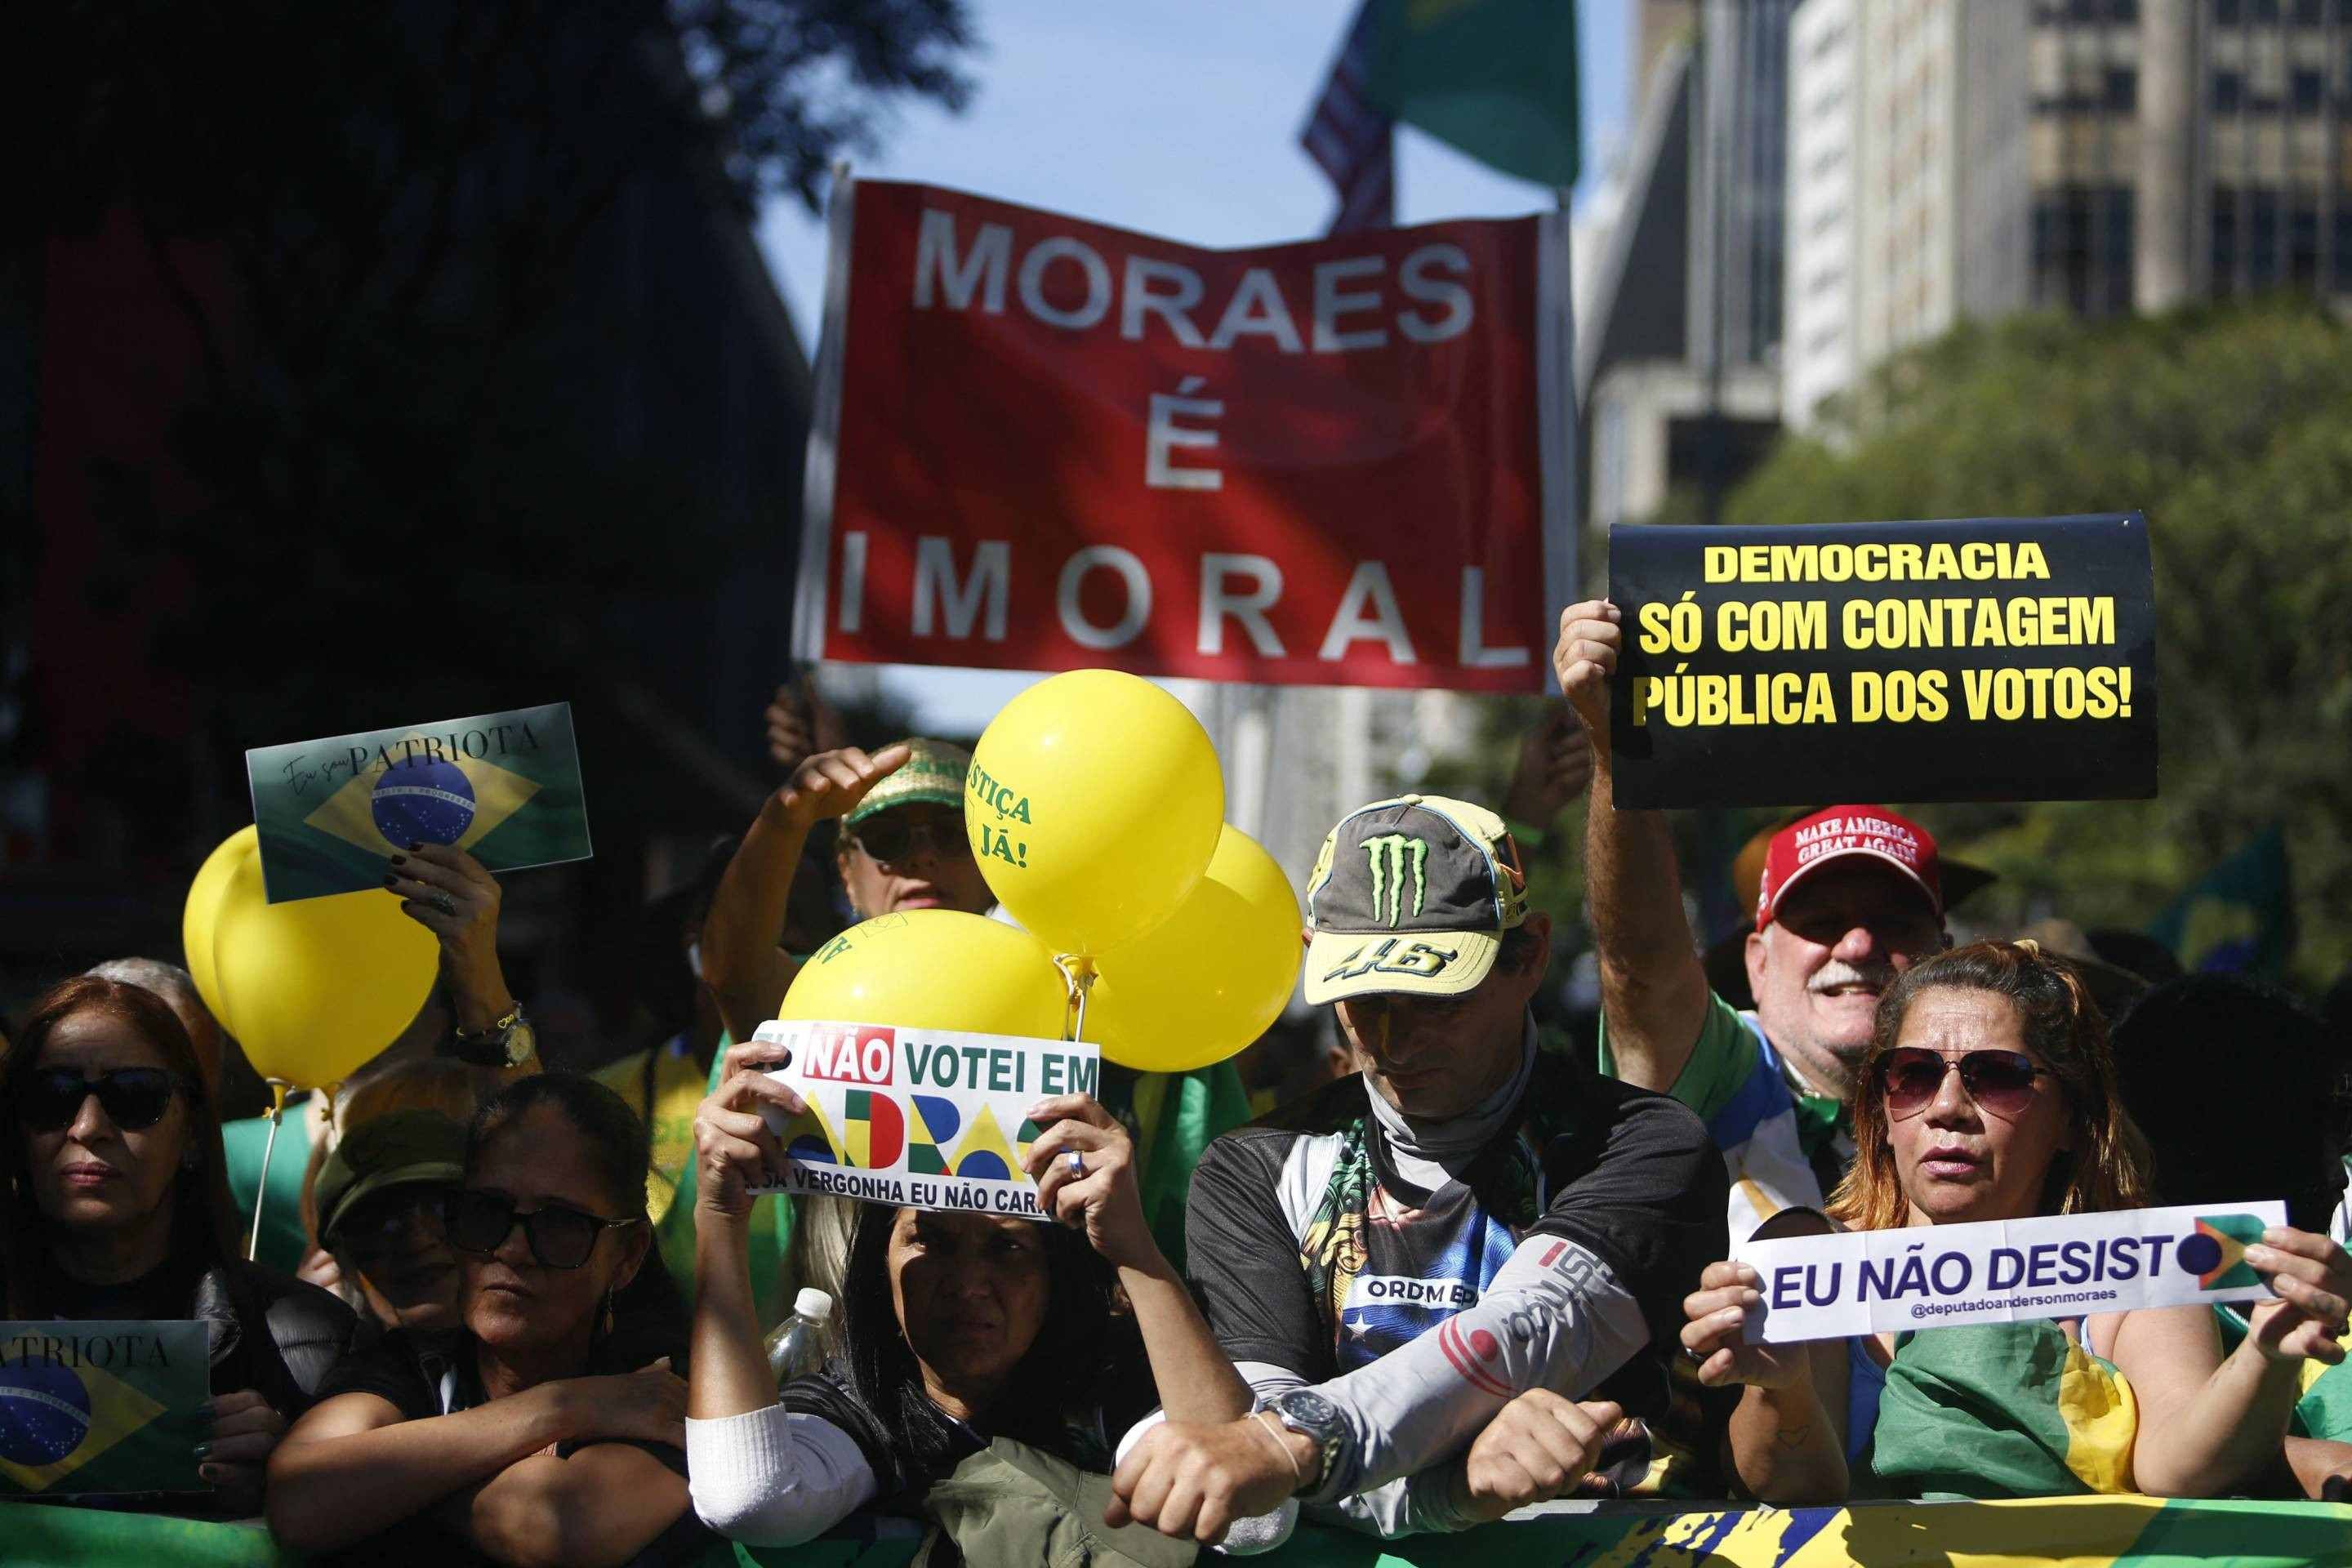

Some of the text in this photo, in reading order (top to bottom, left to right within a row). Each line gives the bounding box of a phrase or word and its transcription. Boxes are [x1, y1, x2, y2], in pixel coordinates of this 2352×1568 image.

[914, 209, 1474, 353] MORAES
[1146, 376, 1225, 491] É
[1704, 542, 2051, 583] DEMOCRACIA
[840, 531, 1530, 668] IMORAL
[1638, 590, 2116, 653] SÓ COM CONTAGEM
[1633, 663, 2132, 727] PÚBLICA DOS VOTOS!
[347, 721, 542, 776] PATRIOTA
[1795, 817, 1918, 848] MAKE AMERICA
[1797, 835, 1918, 864] GREAT AGAIN
[1323, 938, 1459, 982] 46
[805, 1027, 891, 1083] NÃO
[904, 1043, 1026, 1093] VOTEI
[1041, 1053, 1098, 1100] EM
[793, 1168, 905, 1202] VERGONHA
[911, 1182, 938, 1205] EU
[945, 1182, 988, 1209] NÃO
[995, 1188, 1046, 1214] CAR
[1771, 1262, 1842, 1311] EU
[1856, 1242, 1973, 1303] NÃO
[1910, 1287, 2118, 1320] @deputadoandersonmoraes
[0, 1335, 171, 1369] TRIOTA
